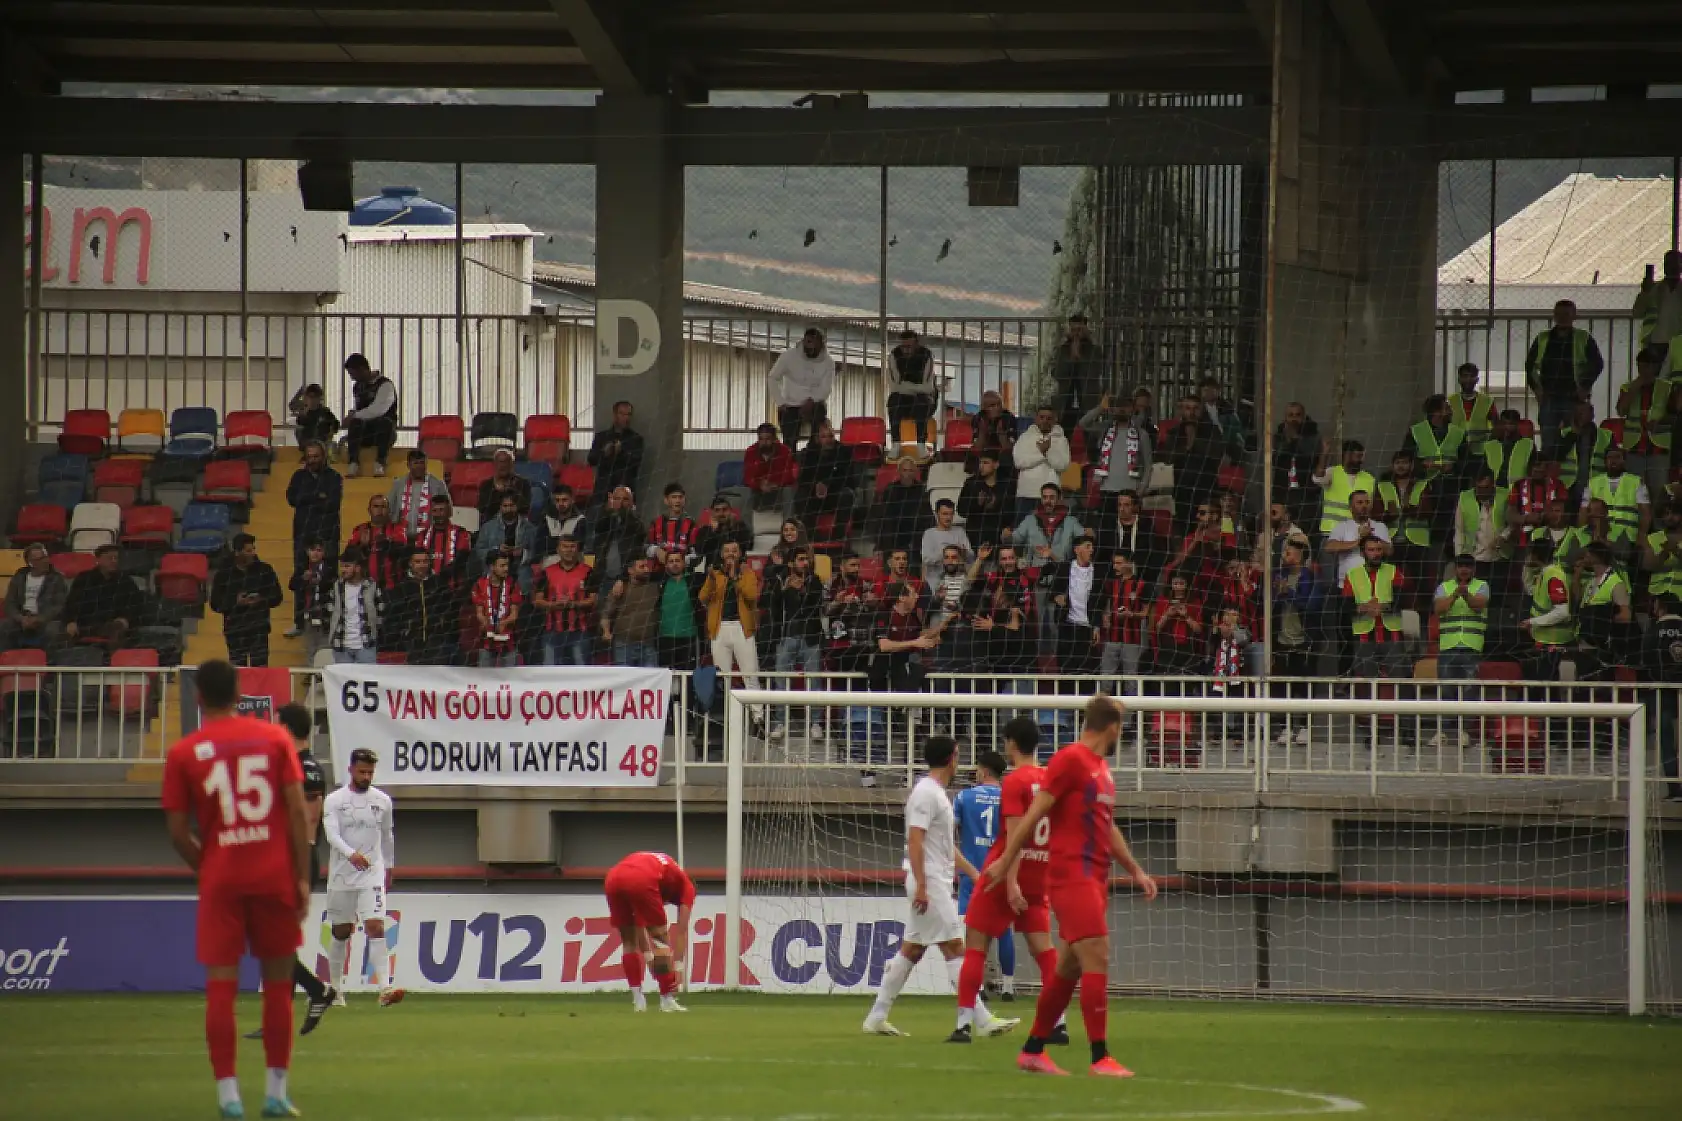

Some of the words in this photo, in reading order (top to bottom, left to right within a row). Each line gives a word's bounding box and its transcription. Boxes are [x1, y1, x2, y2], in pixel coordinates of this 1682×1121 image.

[597, 298, 661, 375] D
[341, 679, 379, 713] 65
[386, 689, 437, 720] VAN
[444, 683, 512, 721] GÖLÜ
[519, 689, 663, 726] ÇOCUKLARI
[394, 740, 502, 772] BODRUM
[510, 741, 607, 772] TAYFASI
[619, 744, 658, 778] 48
[204, 755, 273, 826] 15
[980, 804, 994, 837] 1
[0, 936, 69, 976] ort
[418, 911, 547, 985] U12
[771, 919, 905, 987] CUP
